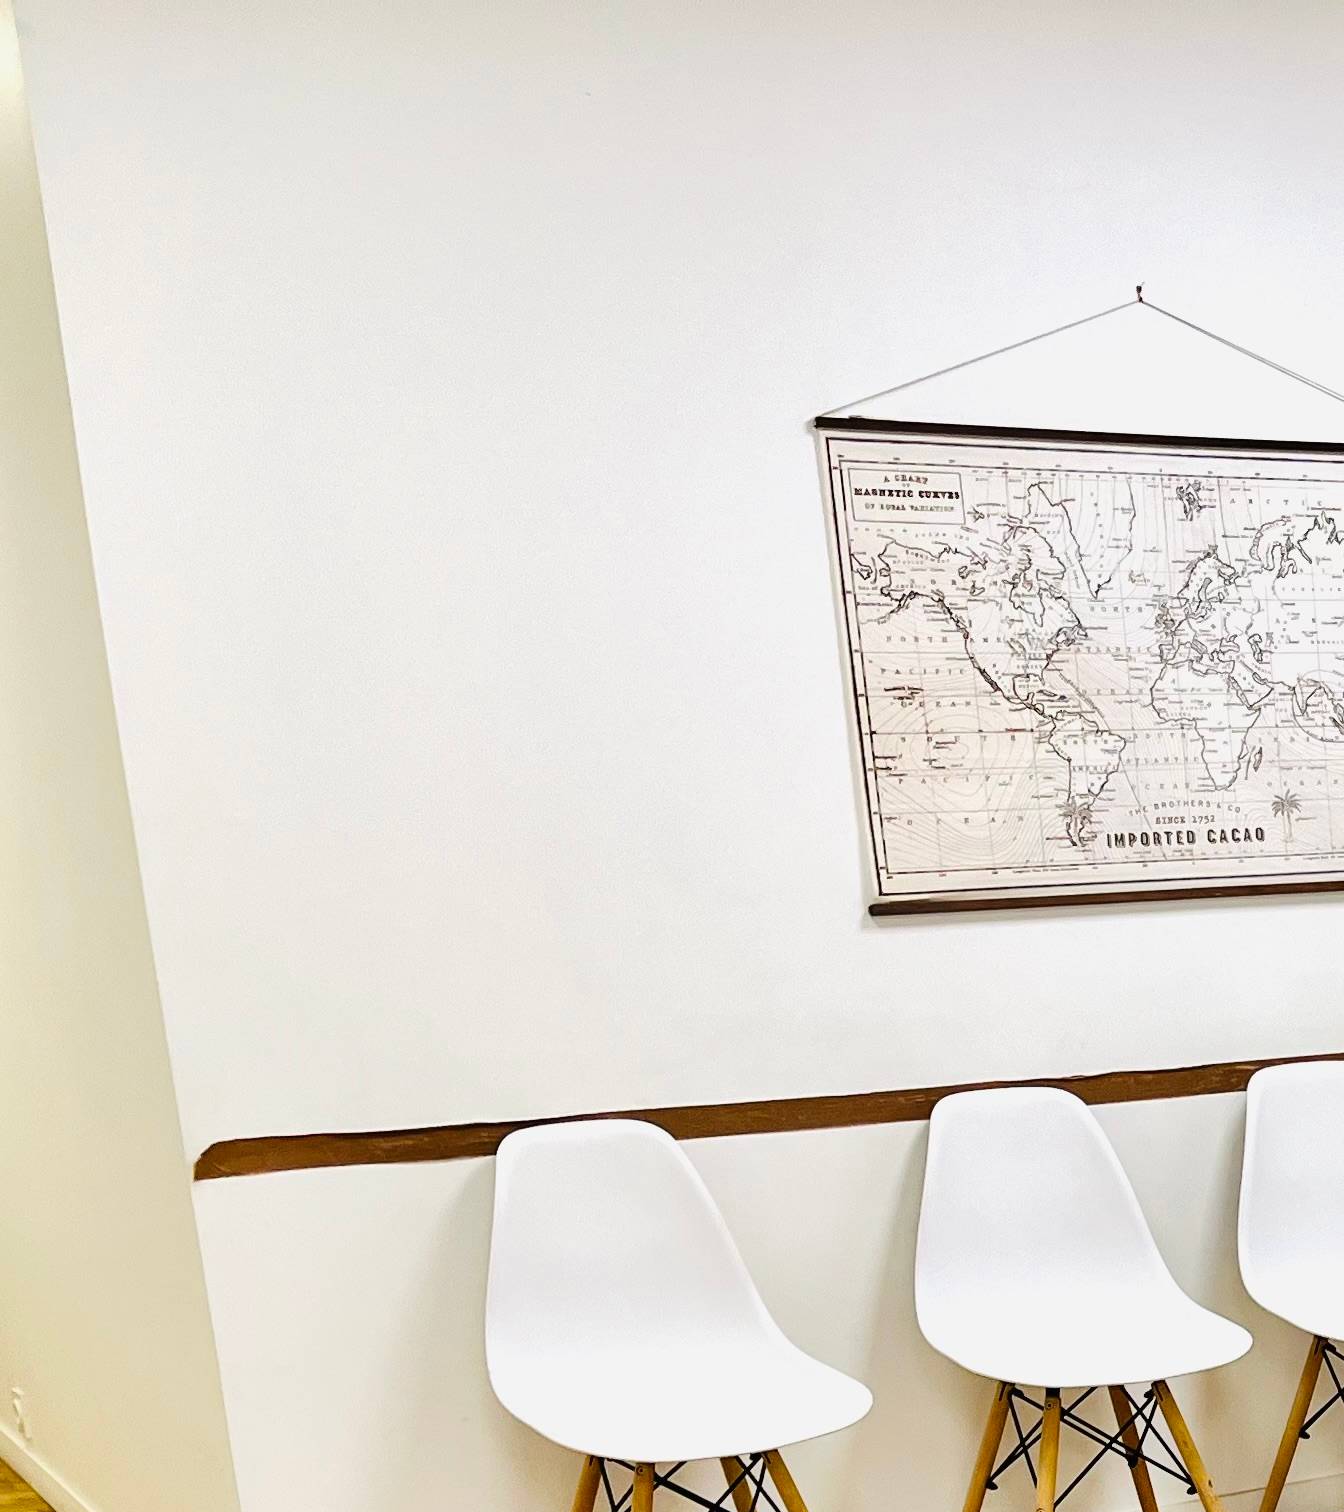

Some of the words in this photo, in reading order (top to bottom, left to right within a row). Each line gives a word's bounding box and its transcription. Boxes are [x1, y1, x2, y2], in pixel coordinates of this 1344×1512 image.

[854, 488, 914, 498] MAGNETIC
[918, 490, 960, 500] CURVES
[1128, 806, 1149, 817] THE
[1154, 800, 1211, 810] BROTHERS
[1155, 816, 1186, 825] SINCE
[1106, 830, 1197, 849] IMPORTED
[1206, 827, 1266, 845] CACAO
